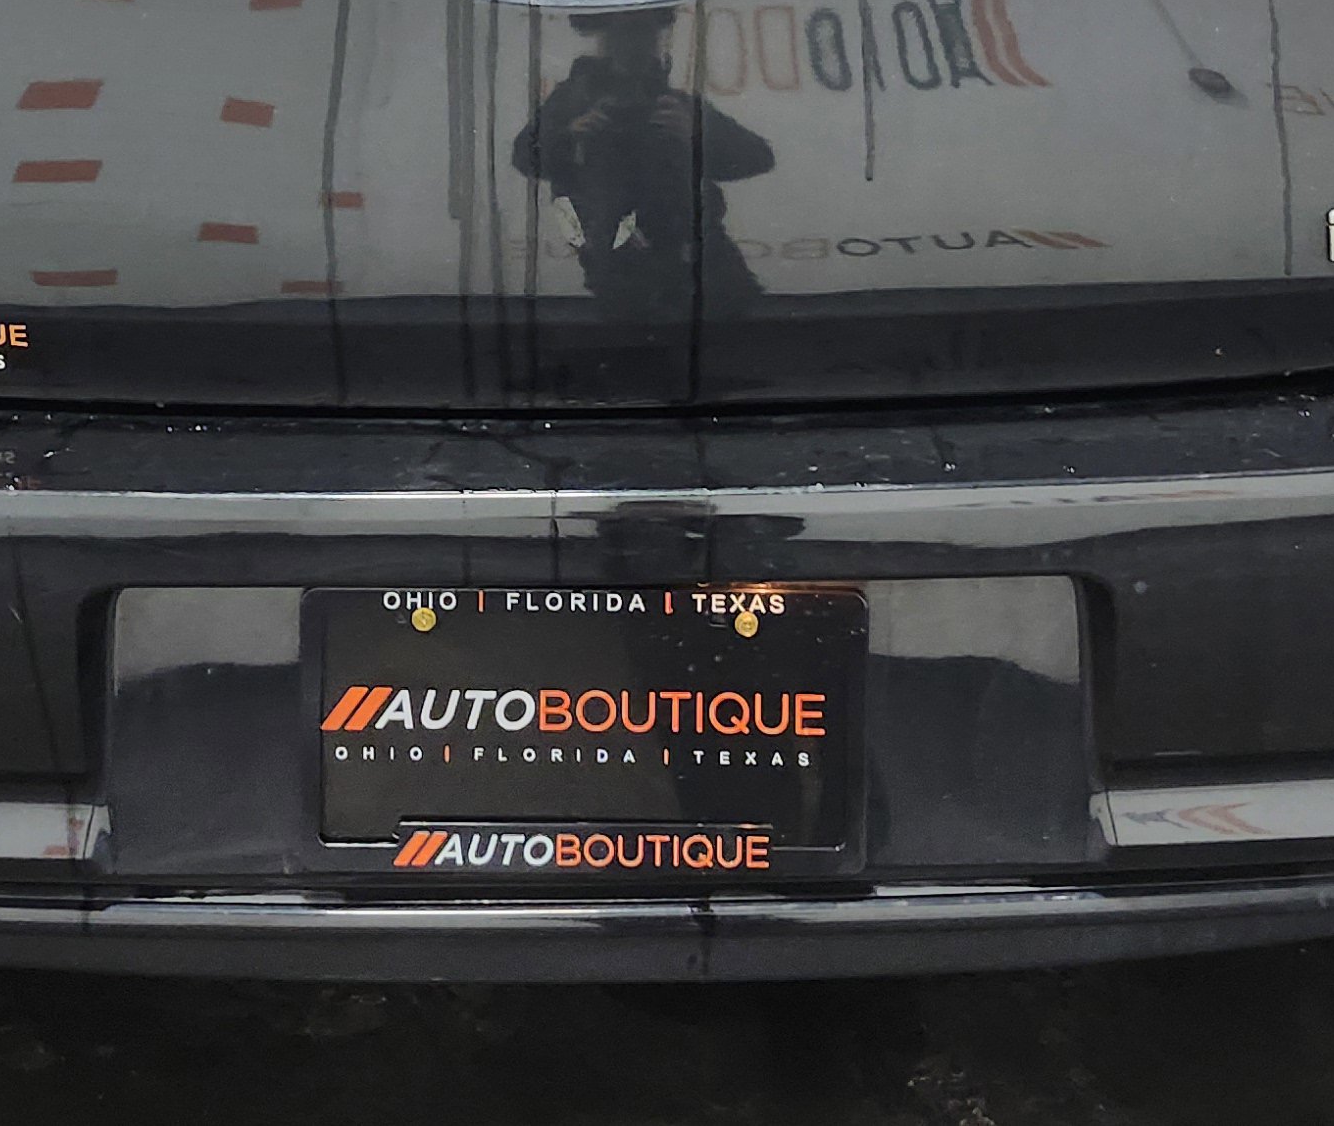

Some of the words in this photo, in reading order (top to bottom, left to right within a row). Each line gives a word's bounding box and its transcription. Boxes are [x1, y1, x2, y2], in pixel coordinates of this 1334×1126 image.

[382, 591, 458, 611] OHIO
[506, 592, 646, 613] FLORIDA
[692, 594, 786, 614] TEXAS
[375, 689, 826, 736] AUTOBOUTIQUE
[335, 746, 424, 762] OHIO
[473, 747, 636, 764] FLORIDA
[693, 750, 810, 767] TEXAS
[434, 833, 770, 869] AUTOBOUTIQUE
